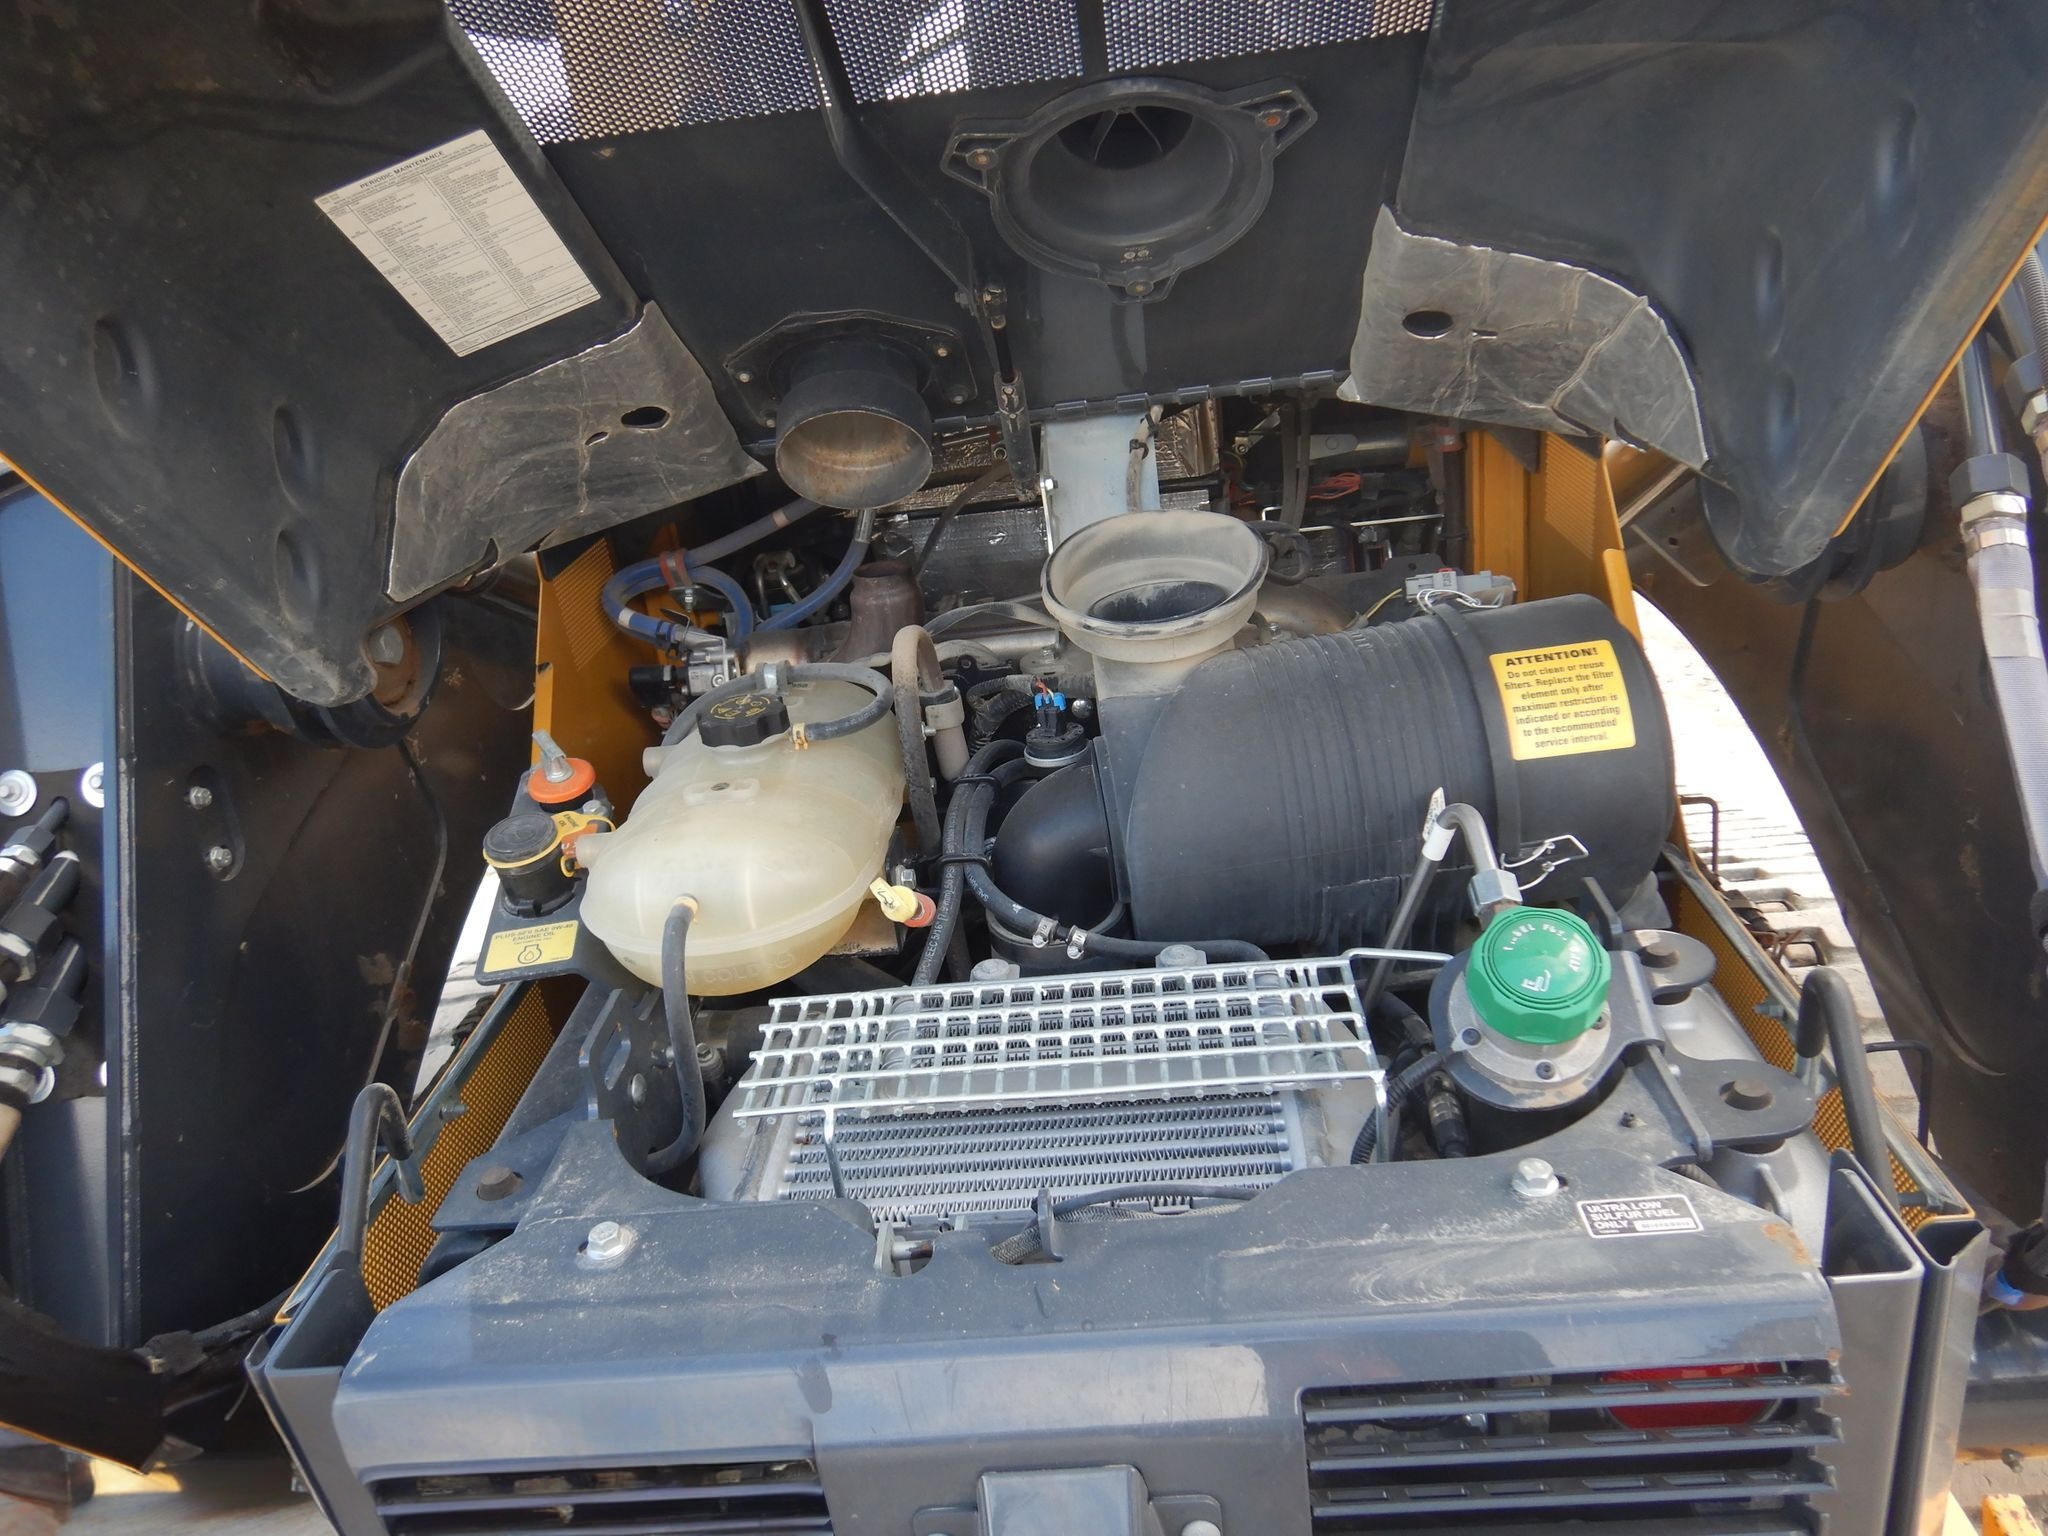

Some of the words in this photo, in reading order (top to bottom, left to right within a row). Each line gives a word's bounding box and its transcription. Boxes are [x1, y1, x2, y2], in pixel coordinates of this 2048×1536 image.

[359, 171, 393, 189] PERIODIC
[393, 150, 445, 174] MAINTENANCE
[1505, 647, 1598, 667] ATTENTION!
[1507, 670, 1520, 679] Do
[1523, 668, 1538, 678] not
[1539, 666, 1565, 675] clean
[1579, 661, 1605, 670] reuse
[1504, 681, 1533, 690] filters.
[1536, 676, 1573, 688] Replace
[1576, 673, 1591, 682] the
[1593, 670, 1614, 679] filter
[1521, 688, 1559, 700] element
[1560, 686, 1580, 696] only
[1583, 683, 1604, 693] after
[1512, 700, 1558, 713] maximum
[1560, 695, 1608, 707] restriction
[1610, 693, 1618, 701] is
[1516, 712, 1560, 725] indicated
[1562, 711, 1571, 720] or
[1573, 706, 1621, 719] according
[1523, 728, 1532, 737] to
[1534, 726, 1549, 735] the
[1551, 718, 1618, 733] recommended
[1535, 737, 1569, 748] service
[512, 934, 541, 942] ENGINE
[1586, 1202, 1631, 1214] ULTRA
[1631, 1201, 1662, 1211] LOW
[1590, 1210, 1643, 1221] SULFUR
[1645, 1208, 1680, 1218] FUEL
[1593, 1220, 1629, 1230] ONLY
